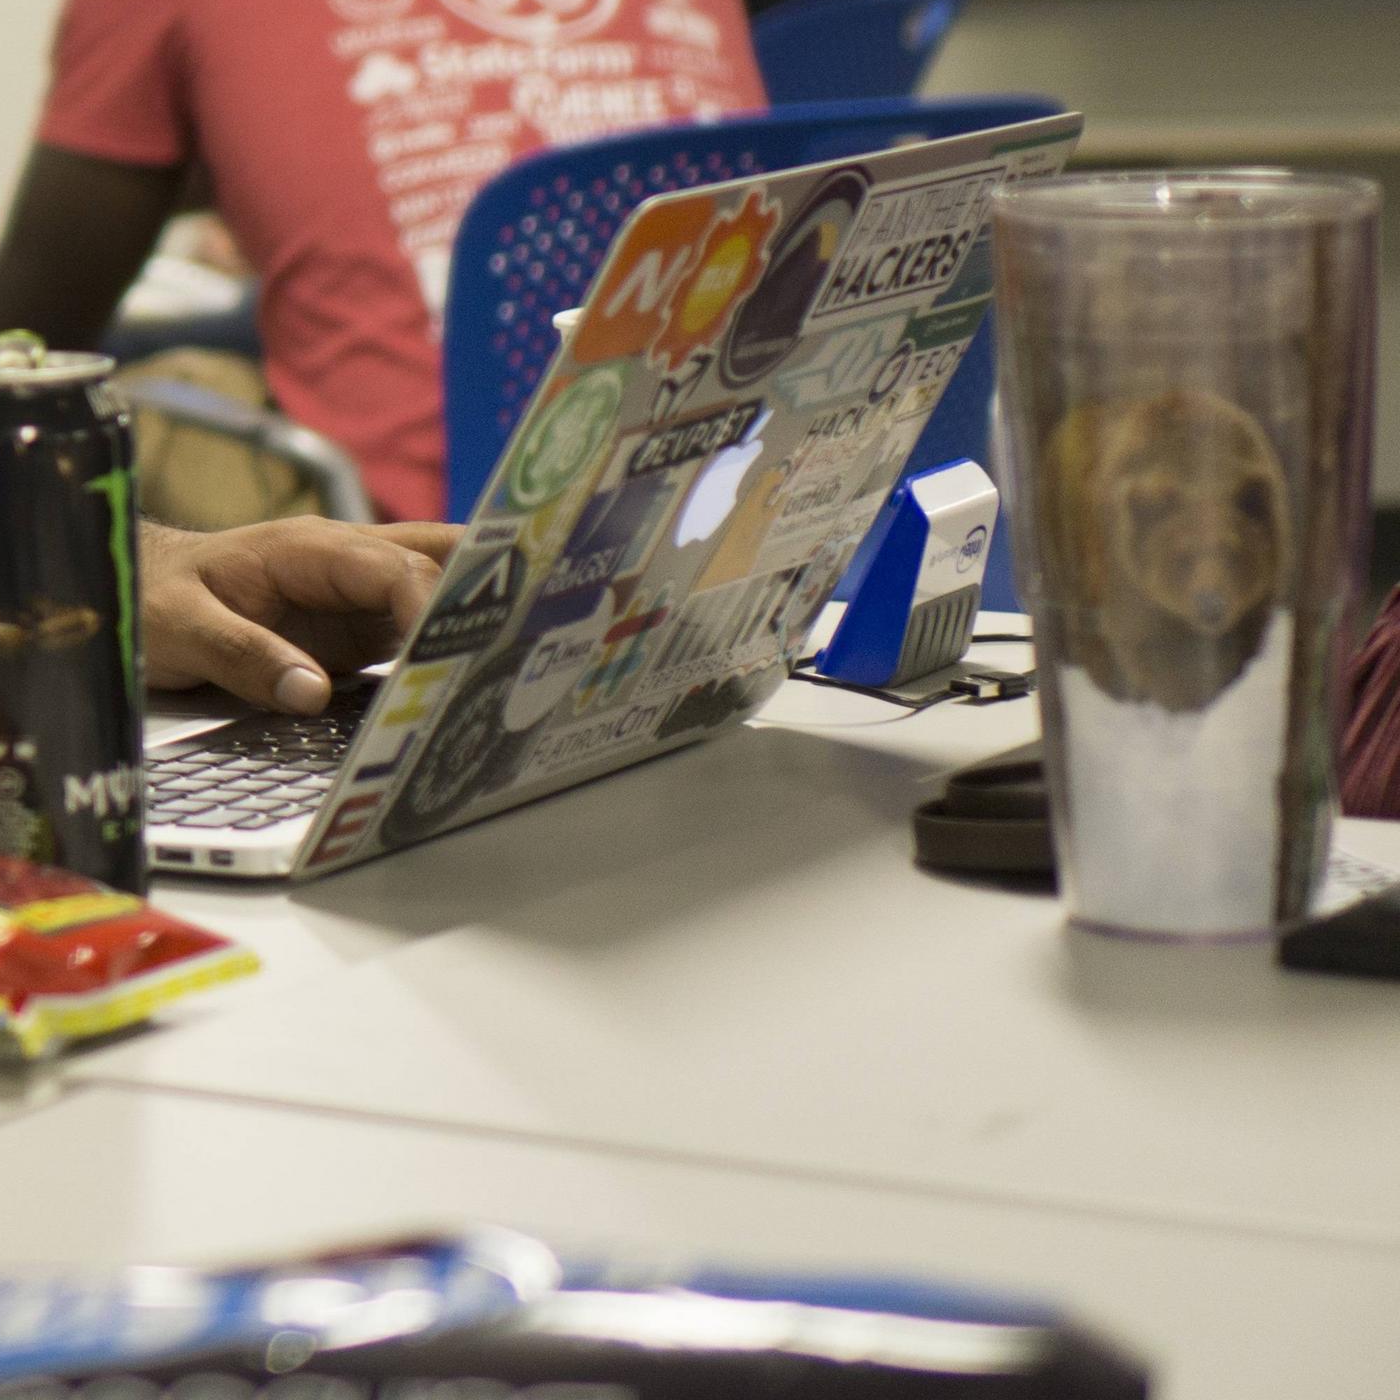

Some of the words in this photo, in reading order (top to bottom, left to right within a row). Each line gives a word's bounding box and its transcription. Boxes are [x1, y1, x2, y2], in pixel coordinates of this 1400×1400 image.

[852, 175, 998, 245] PANTHER
[820, 228, 973, 306] HACKERS
[632, 405, 756, 471] DEVPOST
